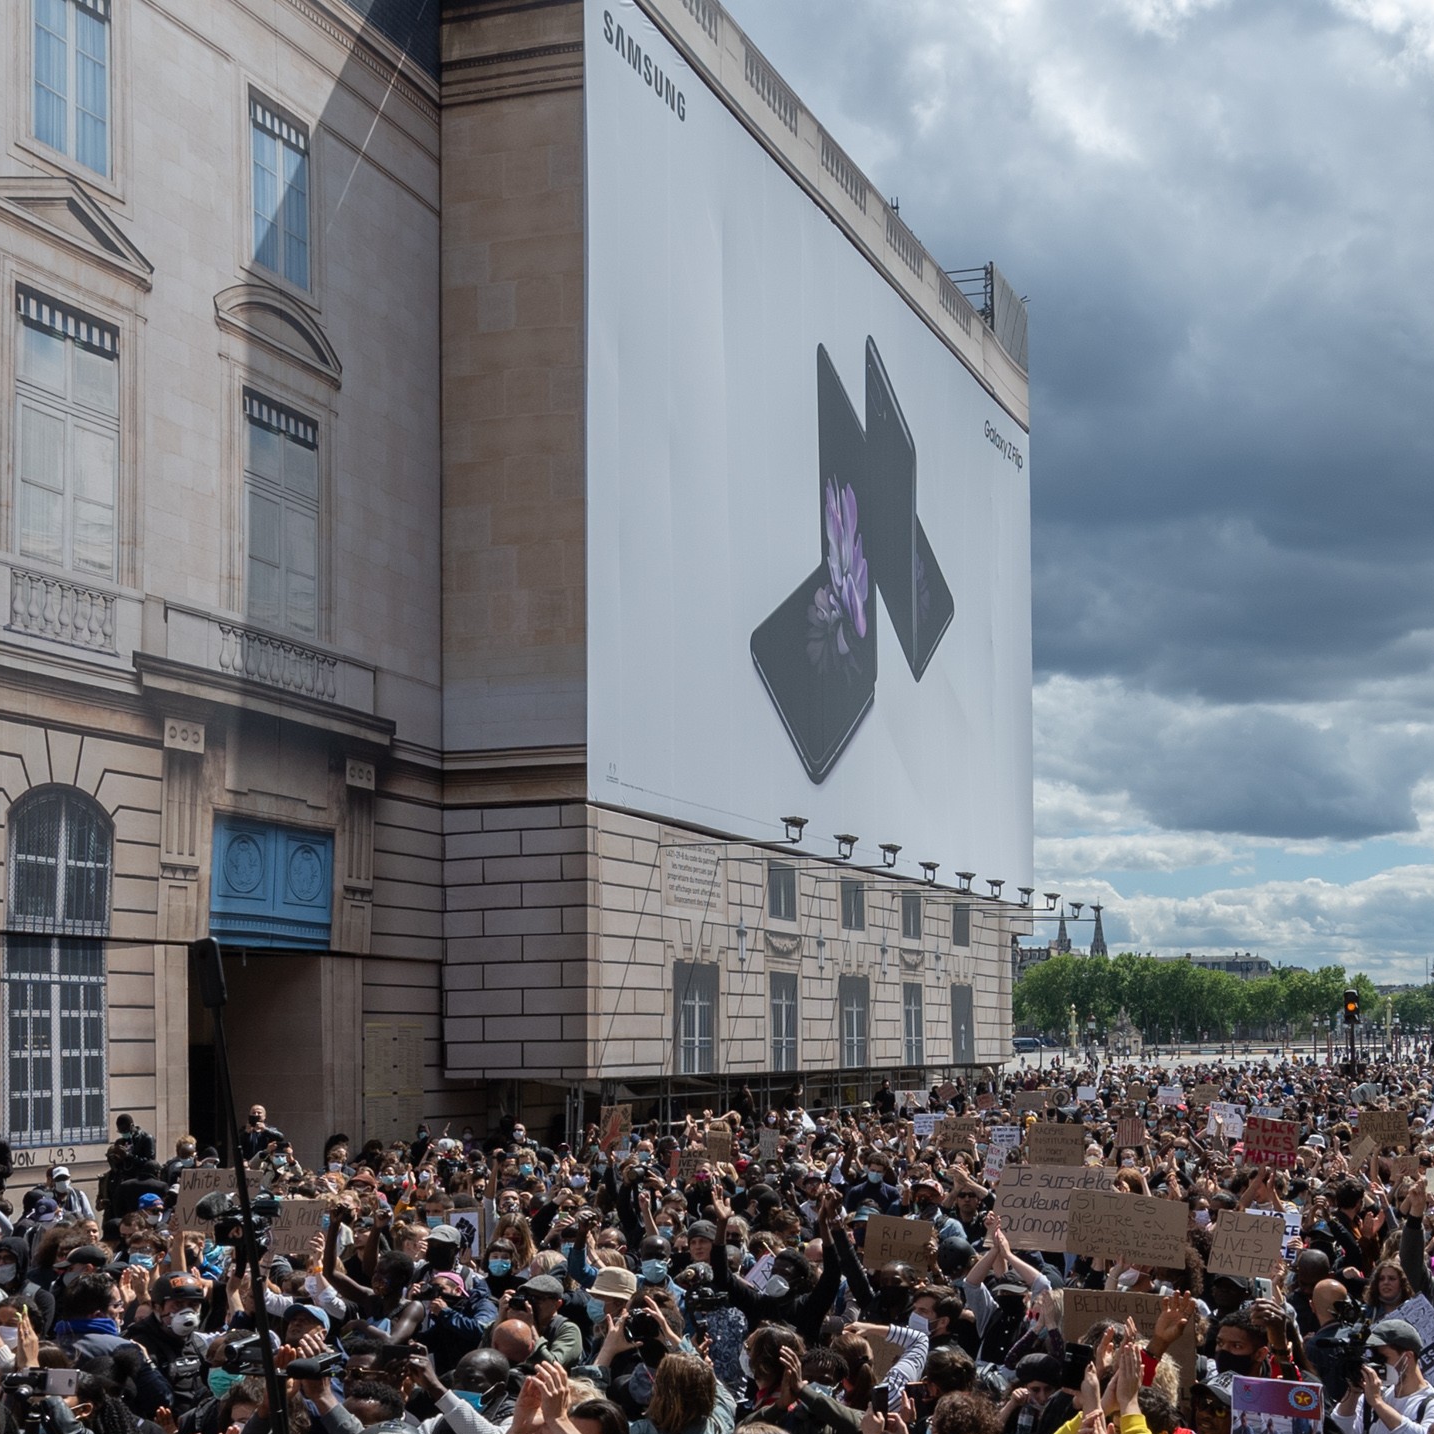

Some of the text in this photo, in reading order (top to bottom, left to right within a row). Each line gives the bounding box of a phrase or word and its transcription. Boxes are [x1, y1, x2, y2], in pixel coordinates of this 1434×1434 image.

[604, 10, 685, 122] SAMSUNG
[1247, 1116, 1296, 1135] BLACK
[1246, 1136, 1295, 1151] LIVES
[49, 1147, 77, 1165] 49.3
[1244, 1149, 1298, 1168] MATTER
[183, 1172, 222, 1191] White
[1002, 1166, 1033, 1188] Je
[1103, 1196, 1126, 1210] TU
[1219, 1210, 1282, 1235] BLACK
[1071, 1232, 1087, 1242] TU
[1212, 1231, 1264, 1254] LIVES
[1074, 1294, 1129, 1315] BEING
